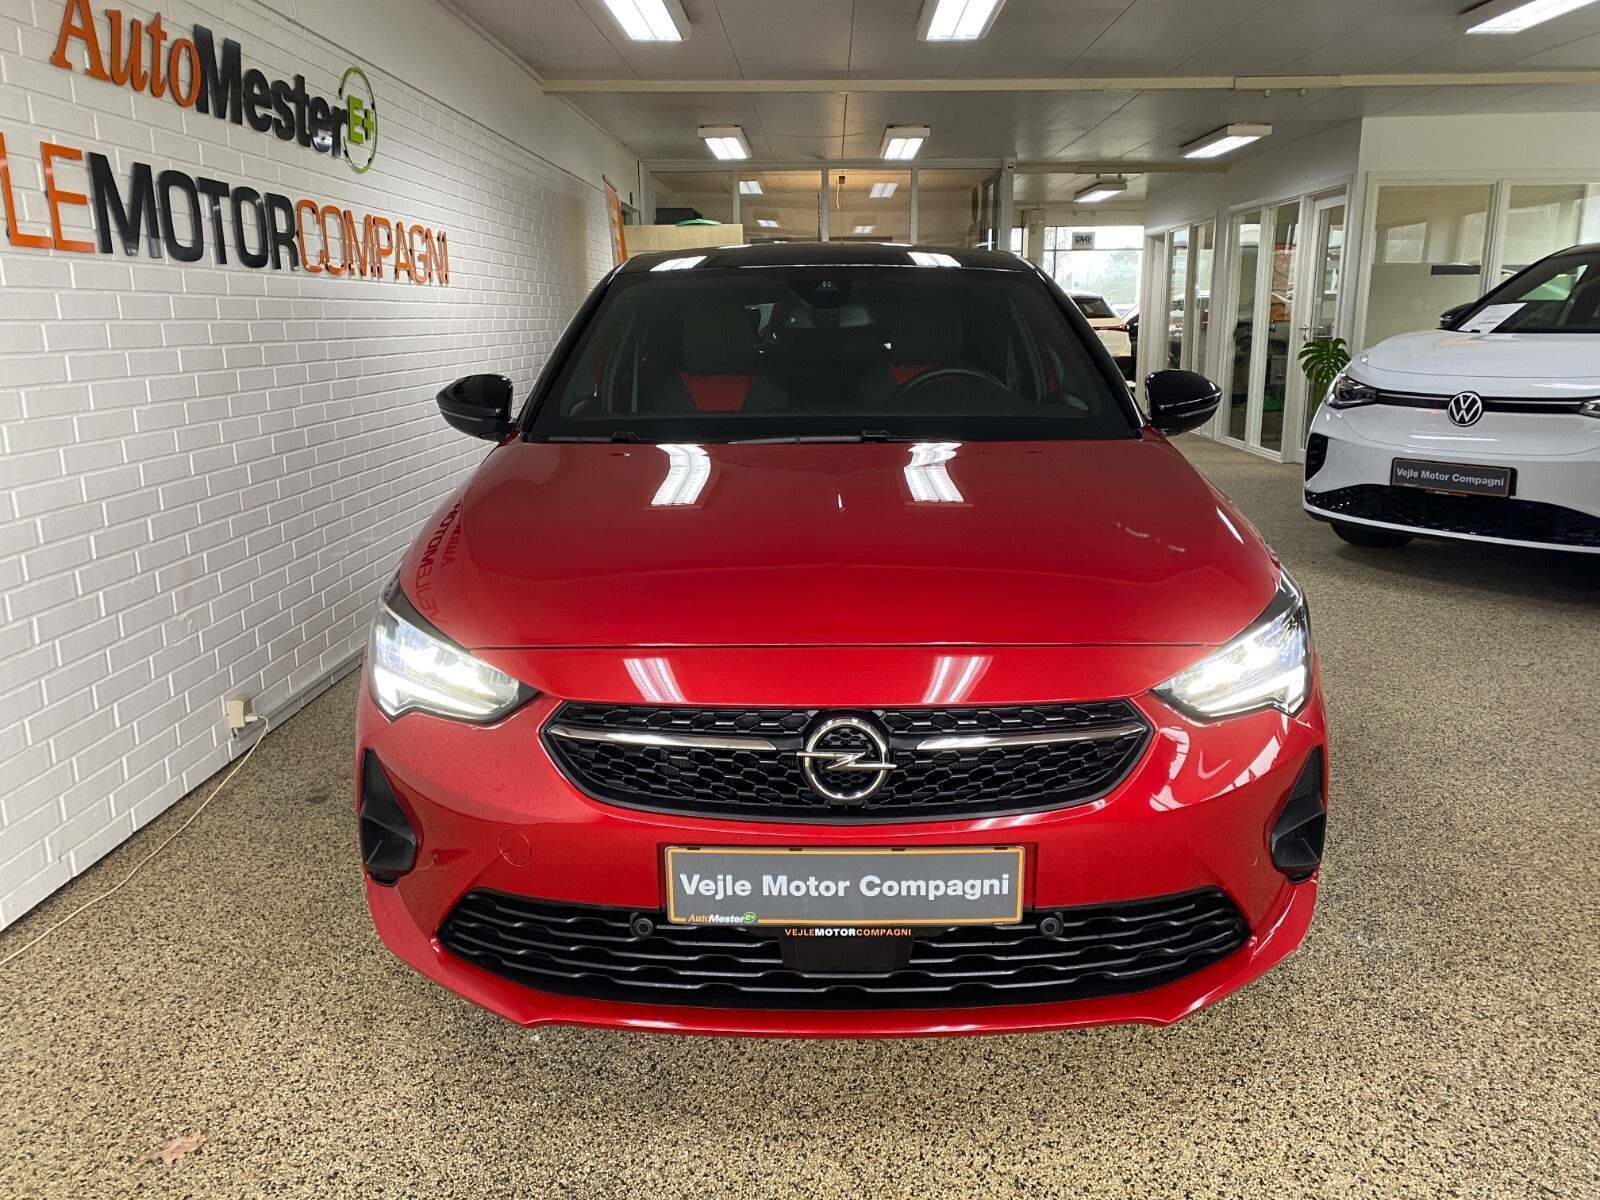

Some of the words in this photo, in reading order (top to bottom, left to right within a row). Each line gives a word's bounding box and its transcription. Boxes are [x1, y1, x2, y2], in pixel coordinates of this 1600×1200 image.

[1396, 467, 1419, 479] Vejle
[1421, 470, 1449, 481] Motor
[1452, 473, 1505, 487] Compagni
[679, 873, 752, 901] Vejle
[761, 875, 850, 897] Motor
[859, 873, 1010, 901] Compagni
[784, 928, 912, 937] VEJLEMOTORCOMPAGNI
